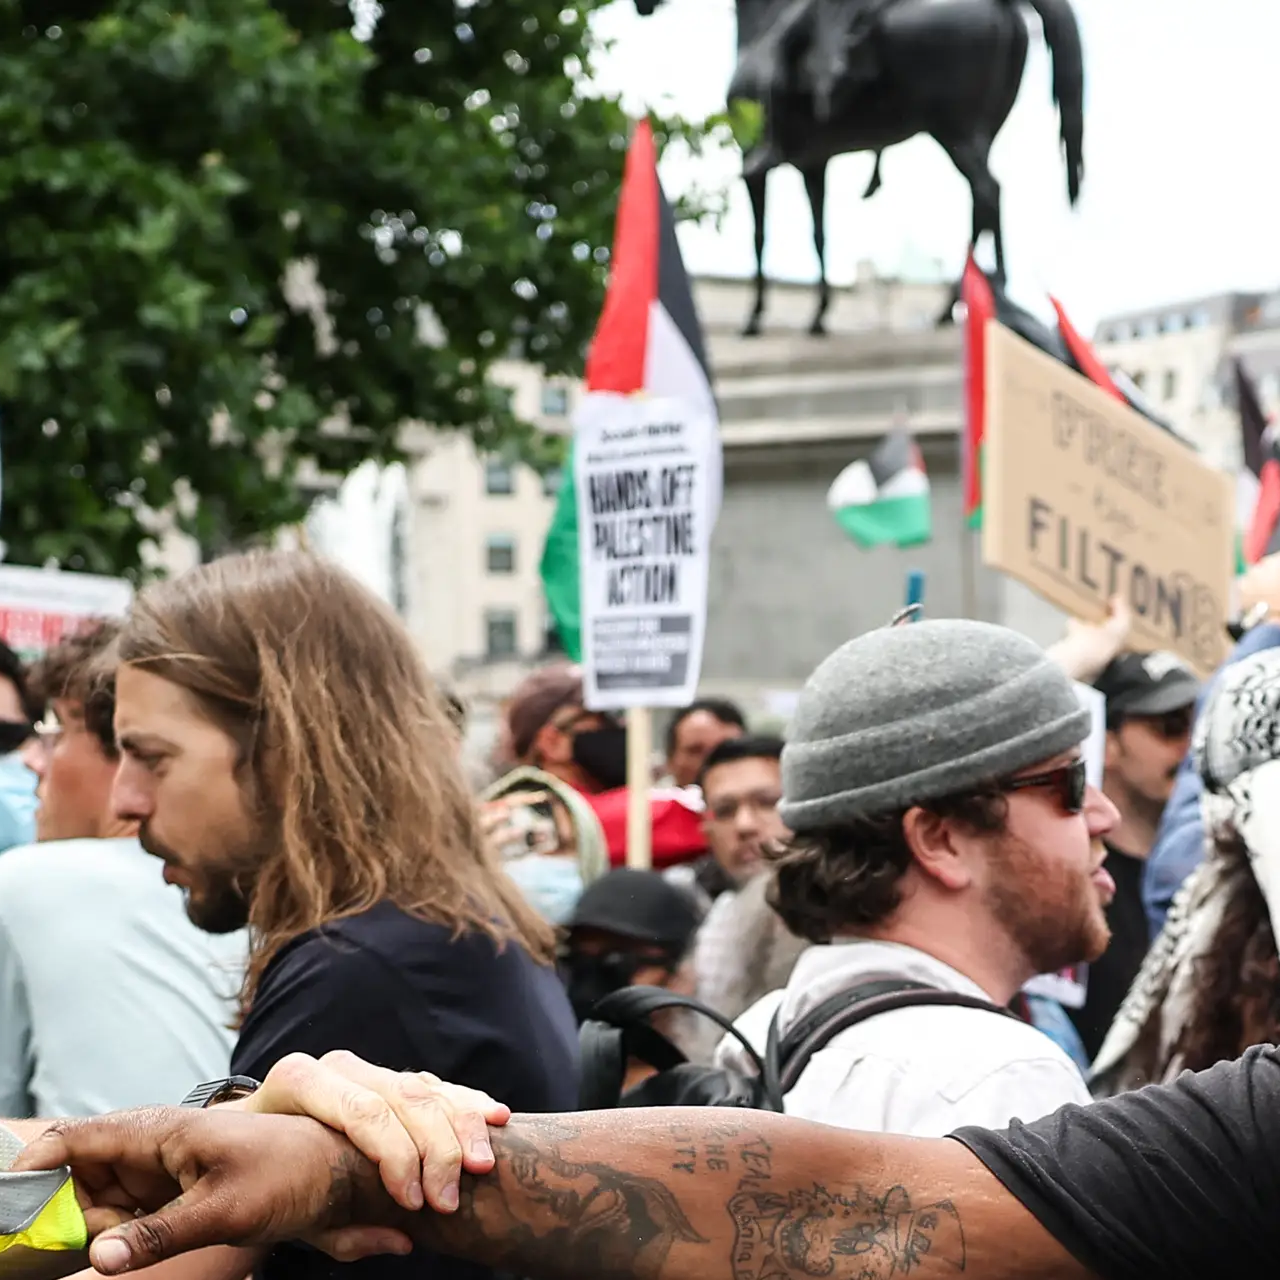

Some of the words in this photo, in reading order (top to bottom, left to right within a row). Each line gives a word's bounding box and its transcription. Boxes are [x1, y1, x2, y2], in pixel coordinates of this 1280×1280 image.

[589, 469, 652, 514] HANDS
[661, 464, 697, 508] OFF
[594, 514, 694, 560] PALESTINE
[608, 563, 679, 607] ACTION
[1028, 494, 1184, 639] FILTON
